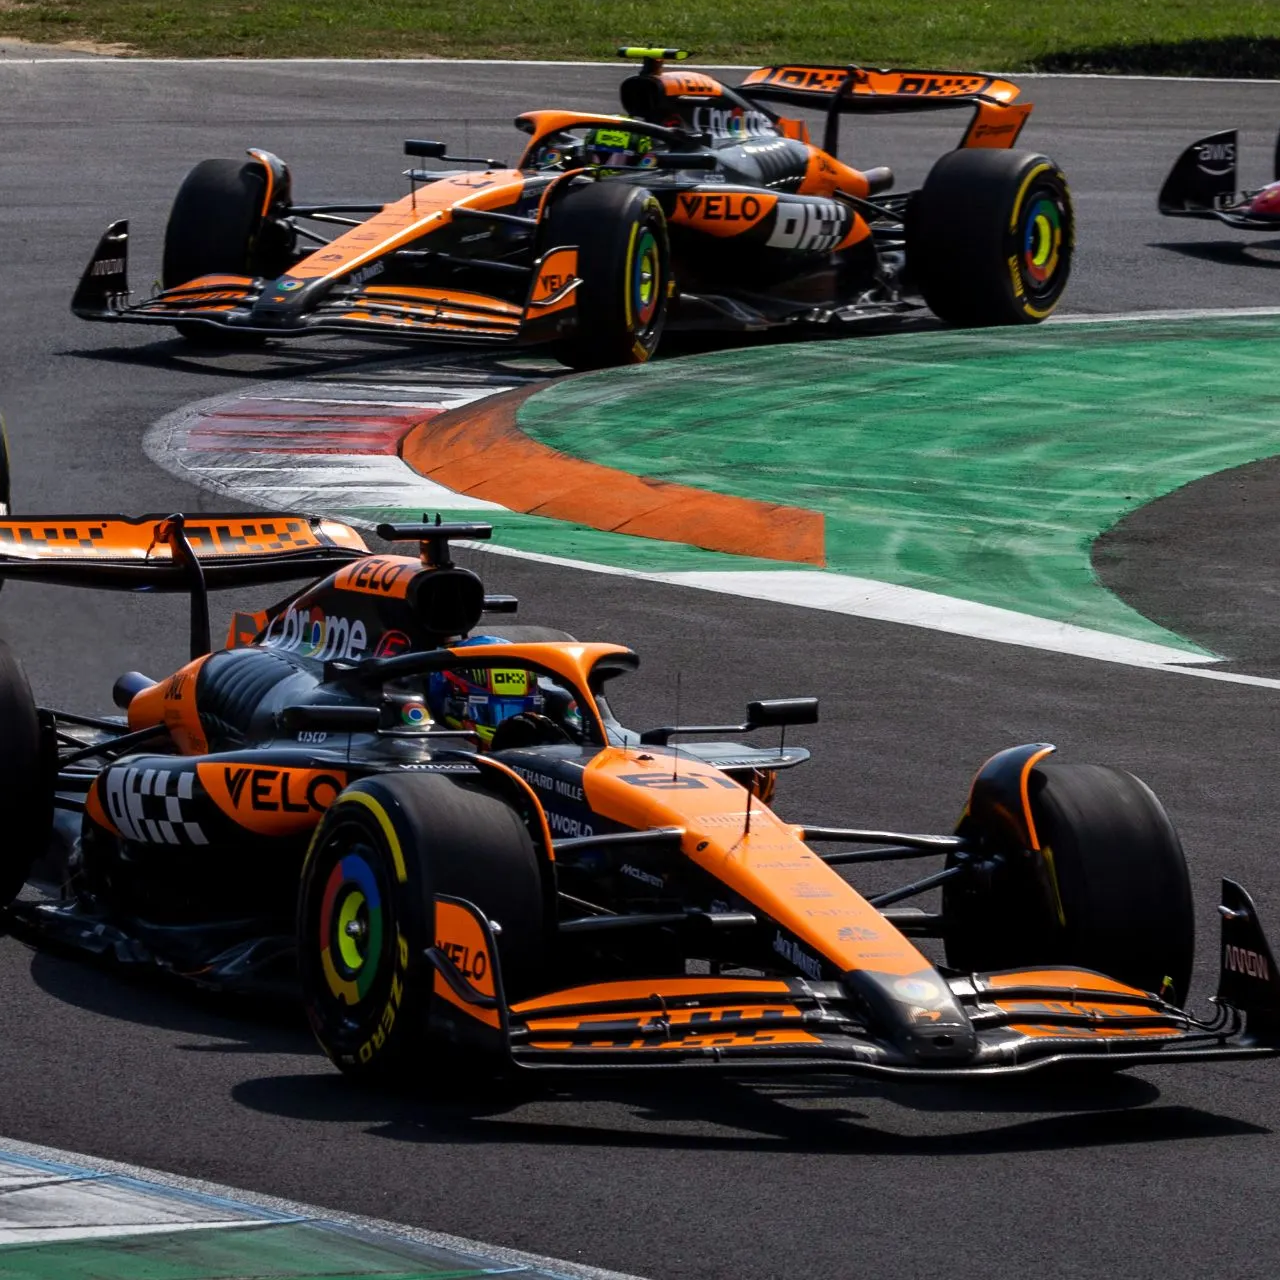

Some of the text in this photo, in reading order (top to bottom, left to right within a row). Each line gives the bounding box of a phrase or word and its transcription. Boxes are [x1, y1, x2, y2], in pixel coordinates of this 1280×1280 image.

[680, 195, 761, 222] VELO
[347, 558, 409, 592] VELO
[493, 672, 526, 685] OKX
[224, 766, 343, 813] VELO
[554, 780, 585, 801] MILLE
[550, 811, 594, 838] WORLD
[619, 863, 665, 890] McLaren
[358, 932, 410, 1064] P ZERO
